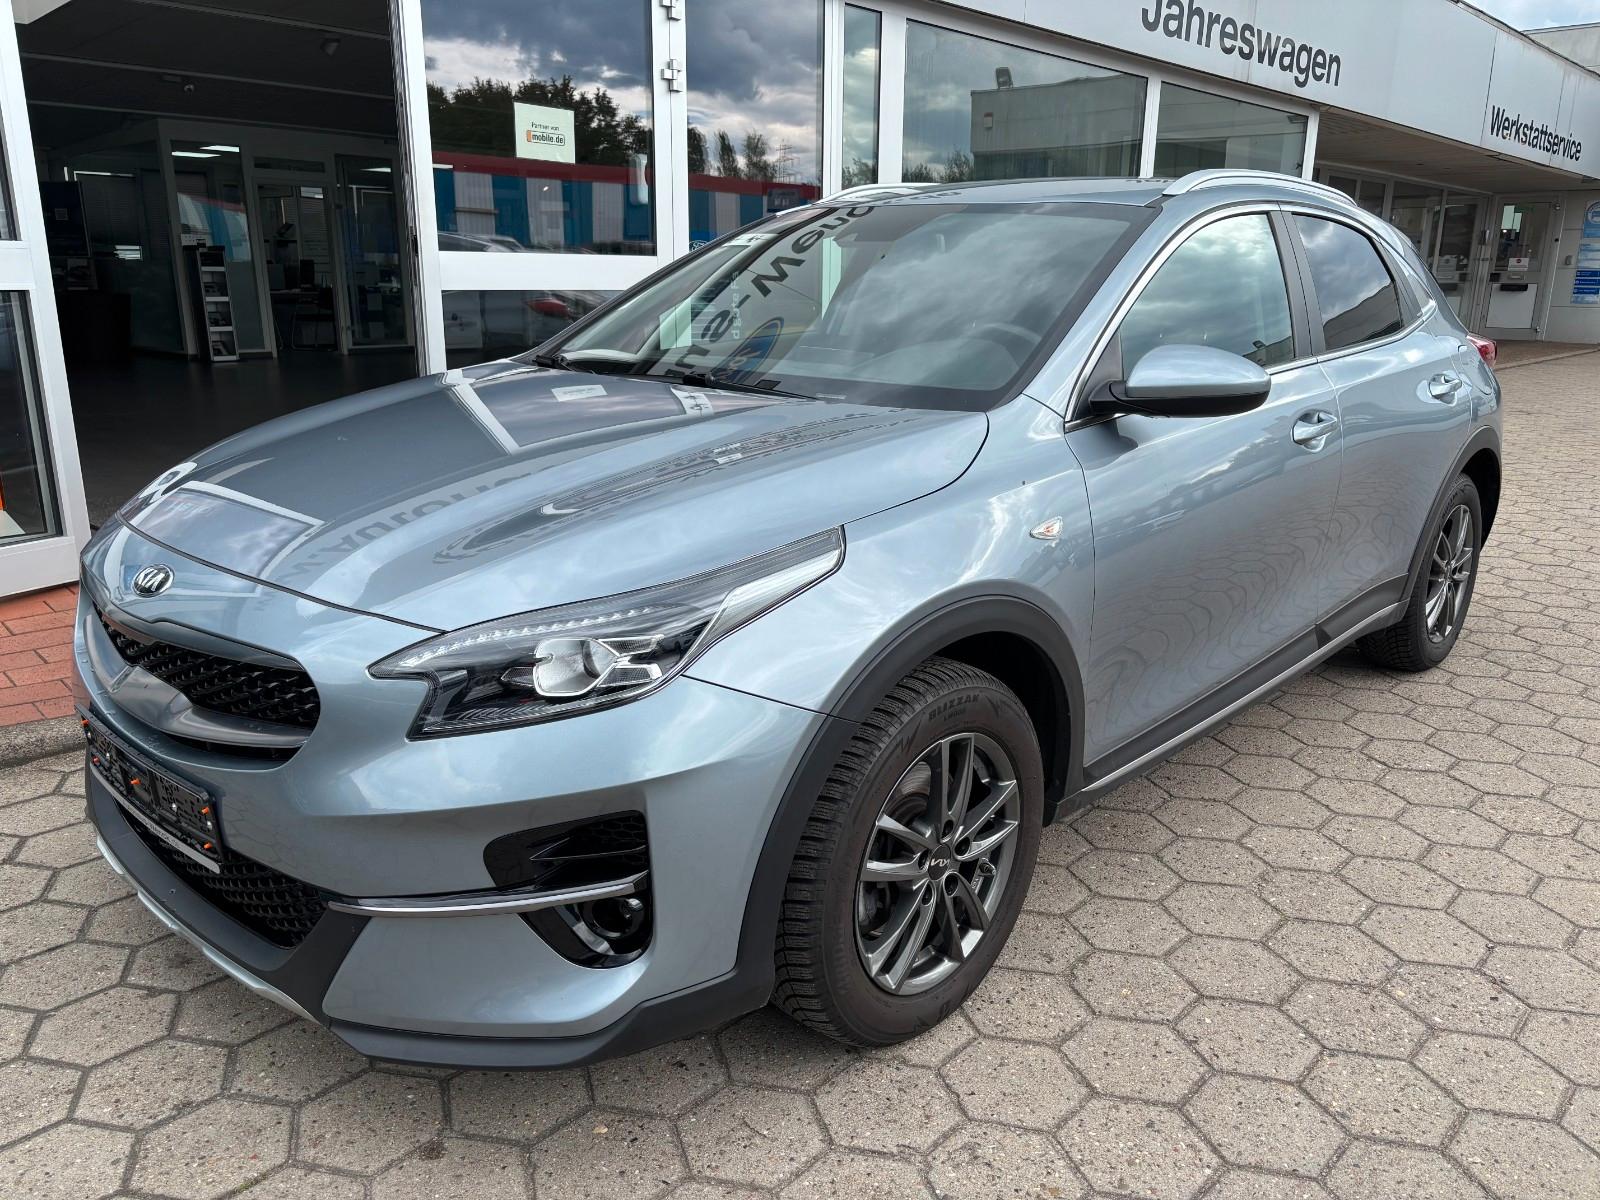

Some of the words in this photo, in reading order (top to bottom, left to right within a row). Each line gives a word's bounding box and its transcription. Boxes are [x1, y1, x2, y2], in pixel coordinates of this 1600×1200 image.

[1141, 0, 1341, 88] Jahreswagen
[532, 133, 564, 144] mobile.de
[1490, 105, 1582, 162] Werkstattservice
